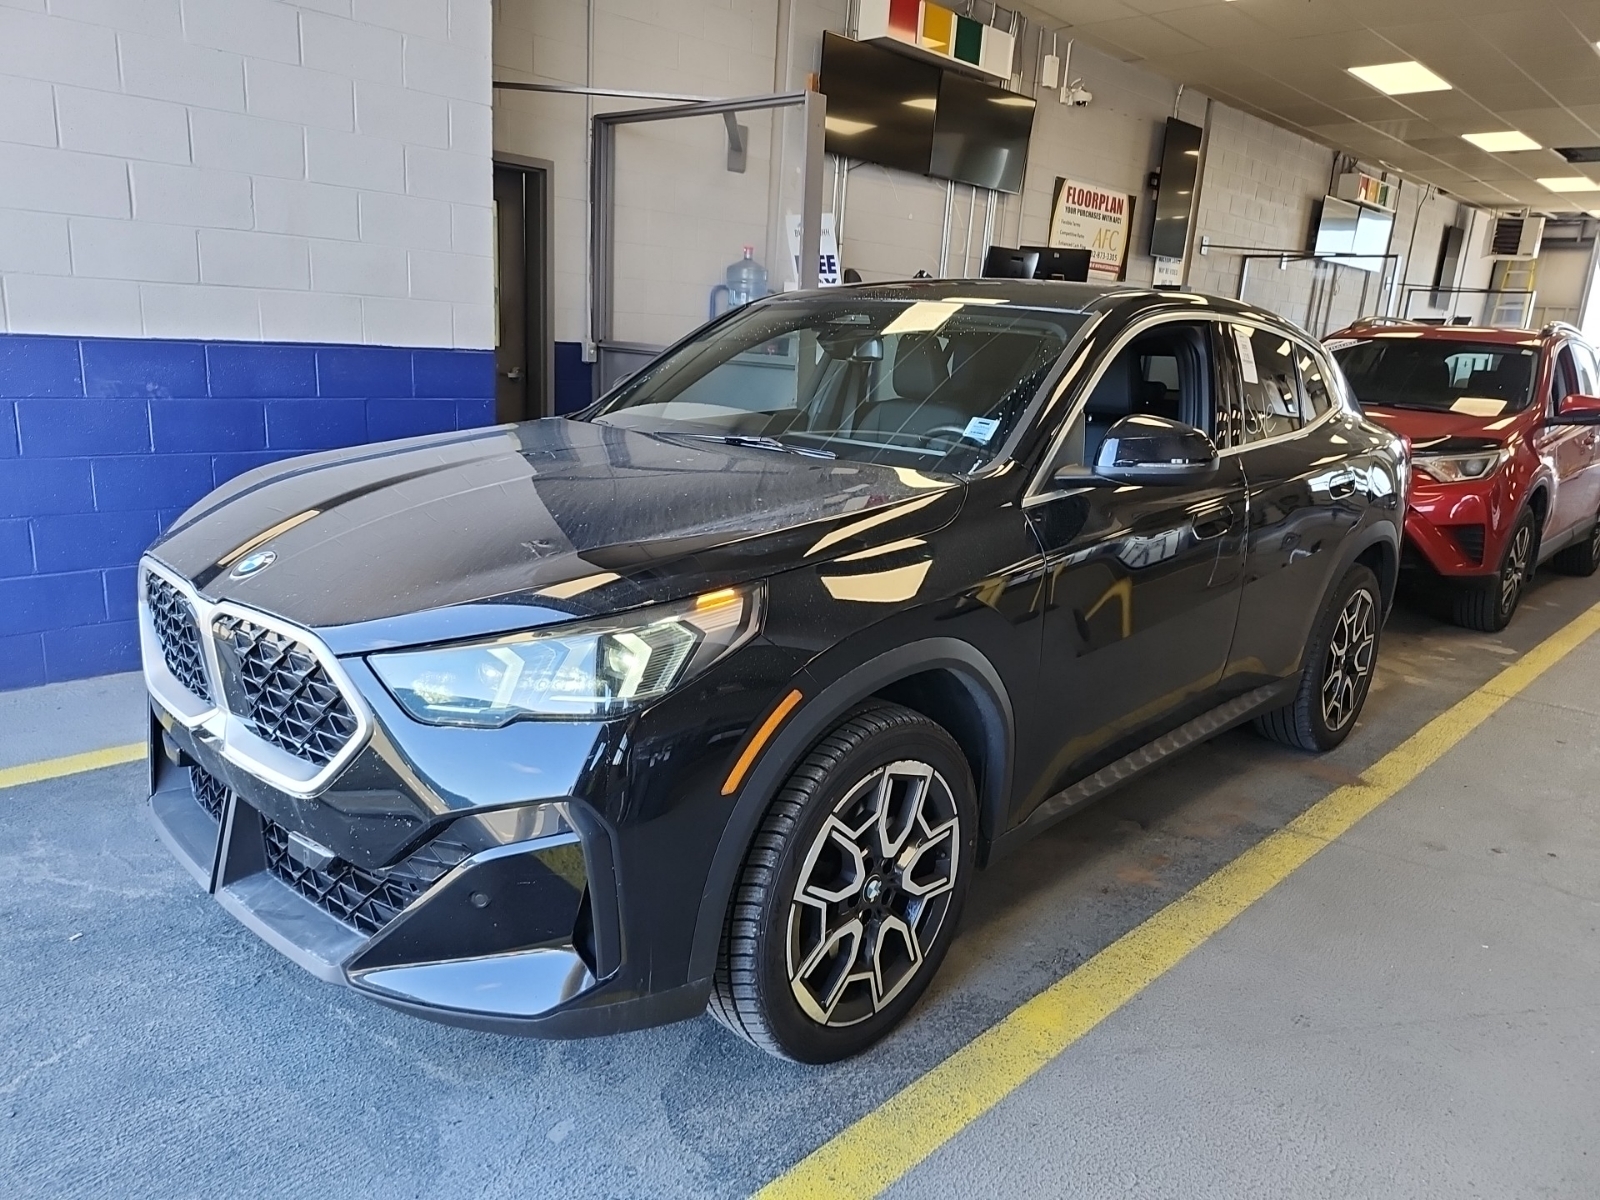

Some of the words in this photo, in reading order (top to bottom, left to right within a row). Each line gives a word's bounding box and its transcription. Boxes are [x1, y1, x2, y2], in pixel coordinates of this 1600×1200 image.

[1066, 185, 1124, 215] FLOORPLAN
[1065, 206, 1076, 215] YOUR
[1076, 208, 1101, 221] PURCHASES
[1101, 213, 1113, 223] WITH
[1092, 227, 1120, 252] AFC
